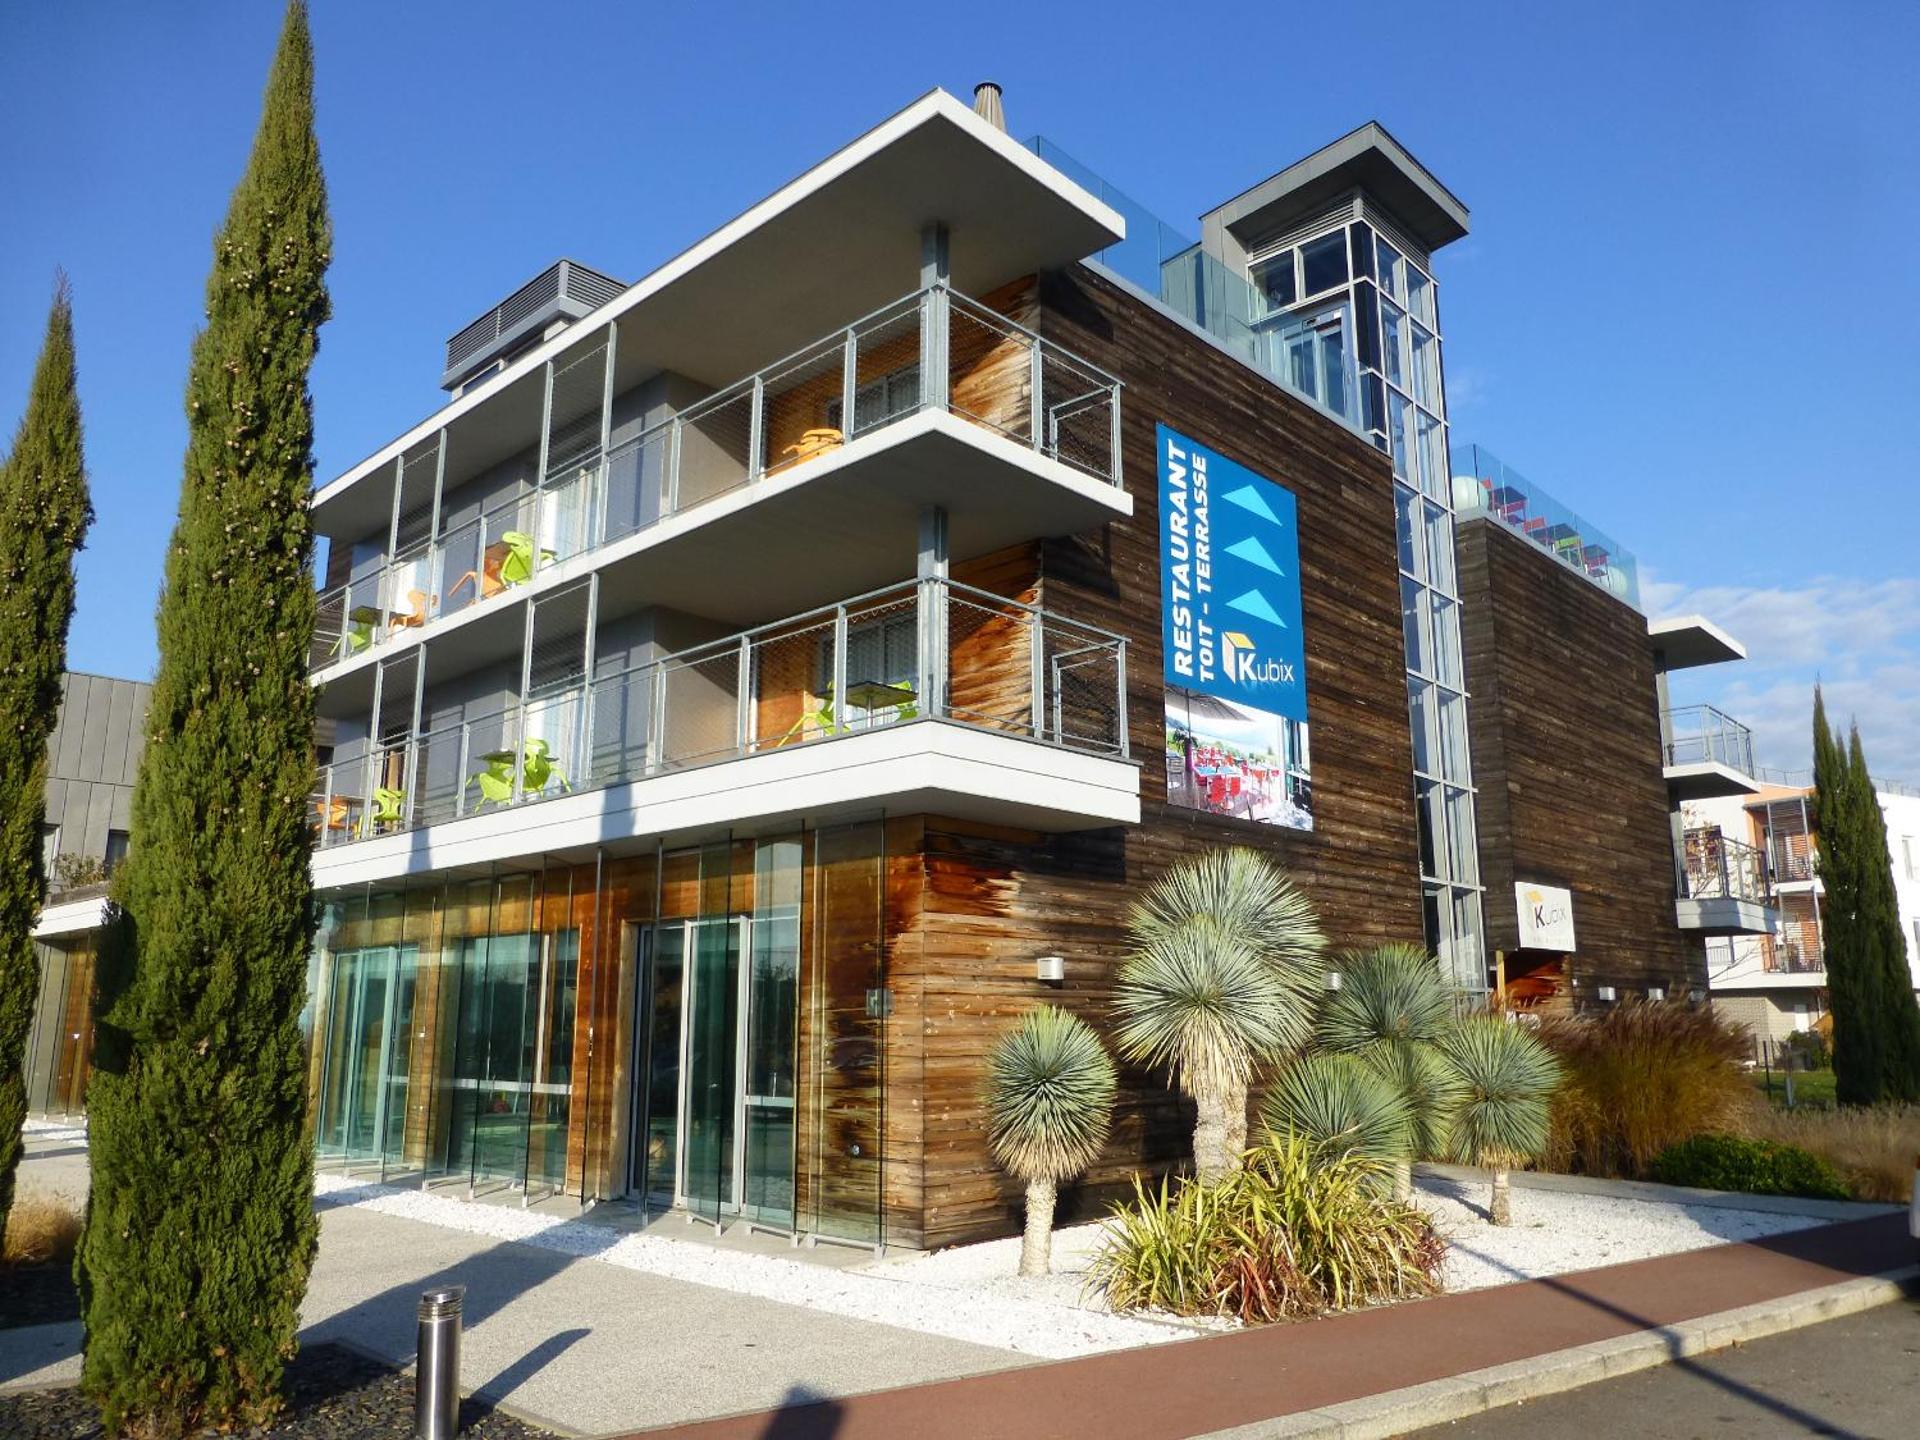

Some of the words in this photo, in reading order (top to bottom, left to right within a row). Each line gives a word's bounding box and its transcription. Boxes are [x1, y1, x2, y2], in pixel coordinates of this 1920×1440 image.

[1168, 439, 1192, 677] RESTAURANT
[1193, 453, 1211, 594] TERRASSE
[1198, 619, 1214, 682] TOIT
[1238, 652, 1294, 682] Kubix
